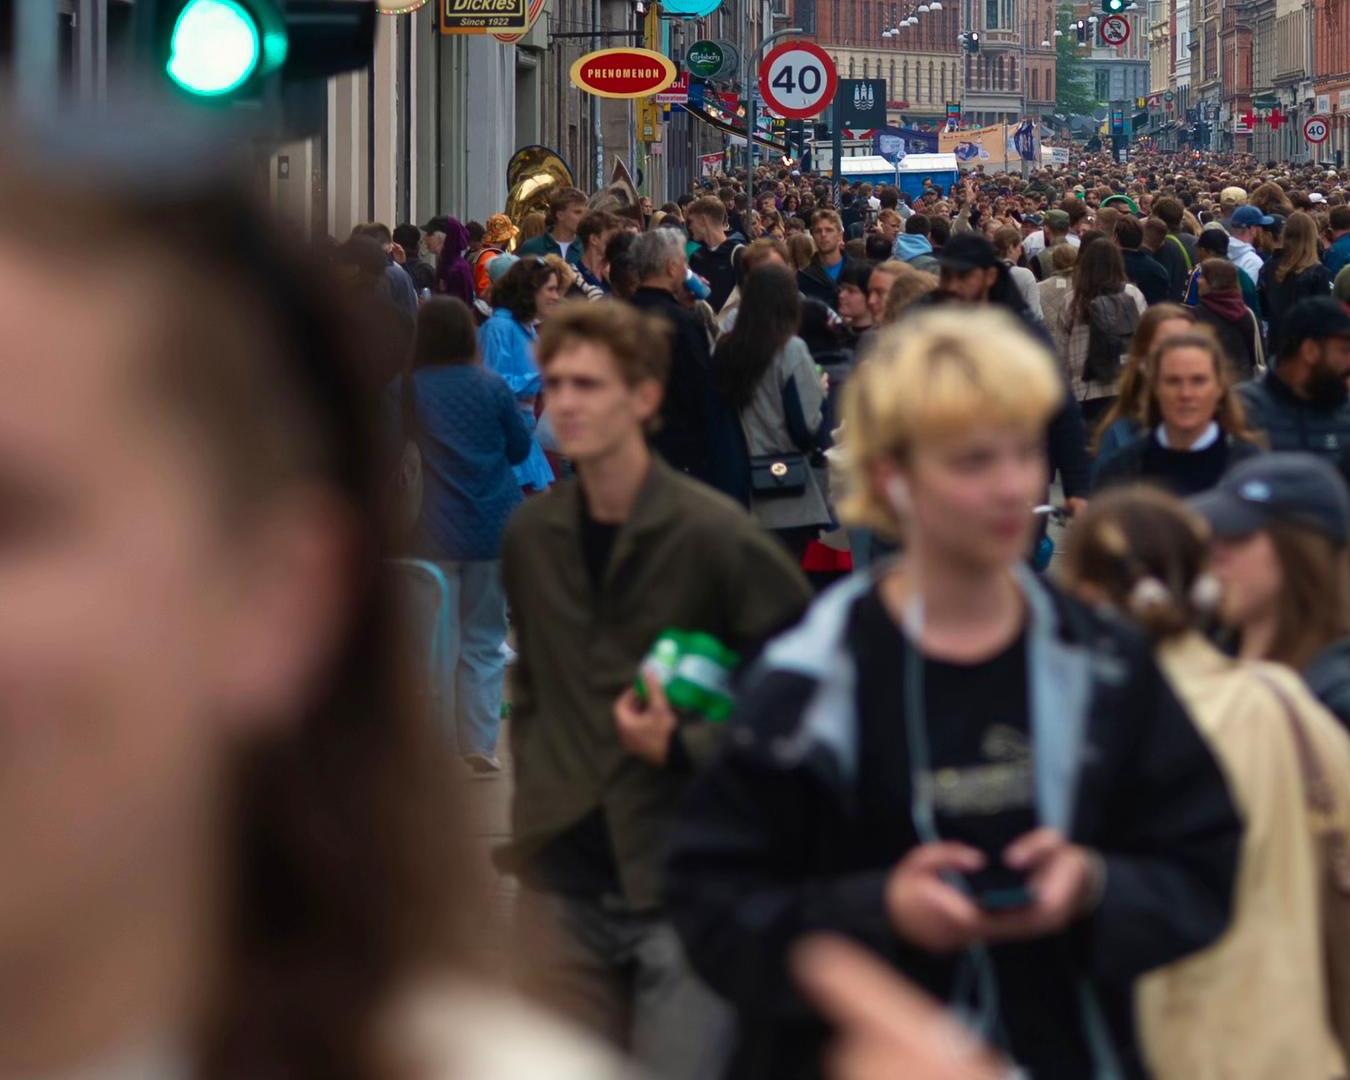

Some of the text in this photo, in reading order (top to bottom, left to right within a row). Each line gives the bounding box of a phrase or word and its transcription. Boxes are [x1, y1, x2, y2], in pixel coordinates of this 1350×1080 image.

[460, 17, 510, 26] Since 1922
[587, 68, 659, 79] PHENOMENON
[771, 65, 822, 94] 40
[1307, 125, 1324, 136] 40
